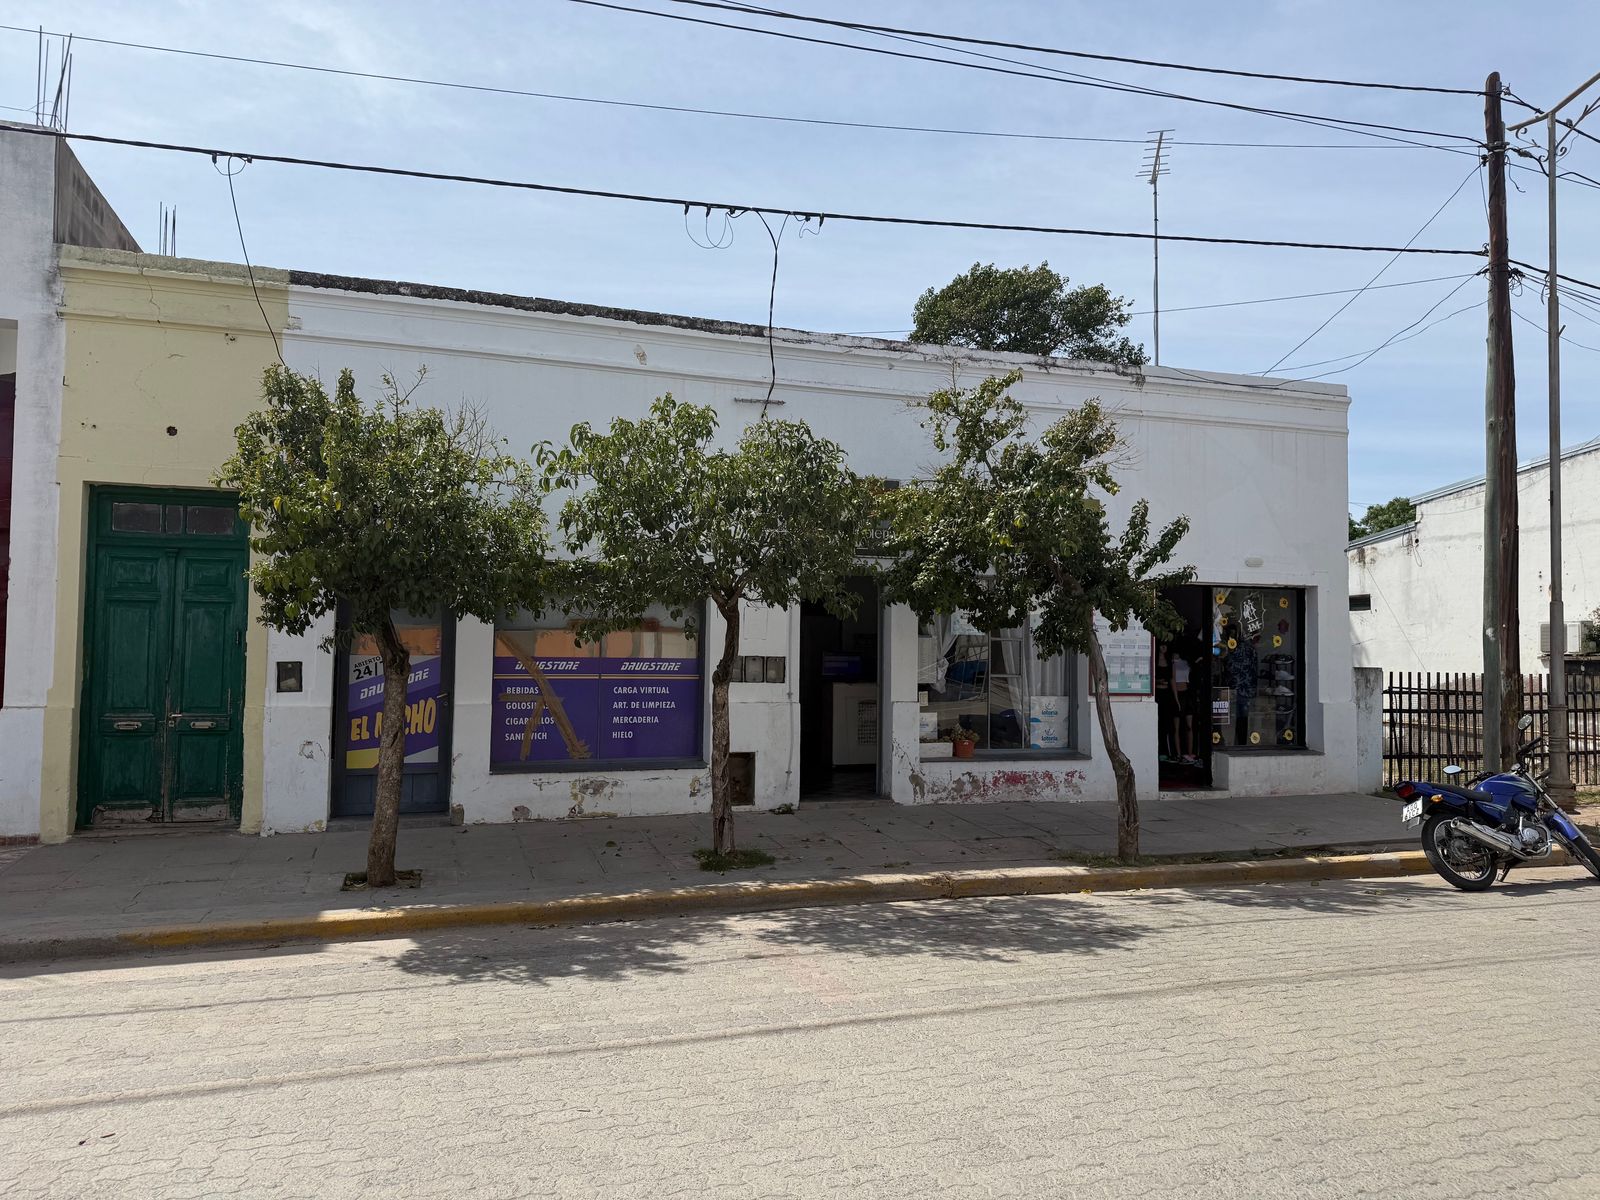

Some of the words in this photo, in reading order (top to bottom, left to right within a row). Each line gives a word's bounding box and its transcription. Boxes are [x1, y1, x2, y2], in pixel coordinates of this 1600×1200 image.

[354, 656, 381, 668] ABIERTO
[515, 661, 580, 670] DGSTORE
[620, 661, 681, 671] DRUGSTORE
[360, 668, 430, 700] DRUORE
[506, 686, 539, 694] BEBIDAS
[613, 686, 638, 694] CARGA
[640, 686, 670, 694] VIRTUAL
[612, 701, 629, 709] ART.
[631, 701, 640, 709] DE
[641, 701, 676, 709] LIMPIEZA
[612, 716, 659, 724] MERCADERIA
[351, 716, 370, 741] EL
[612, 731, 634, 739] HIELO
